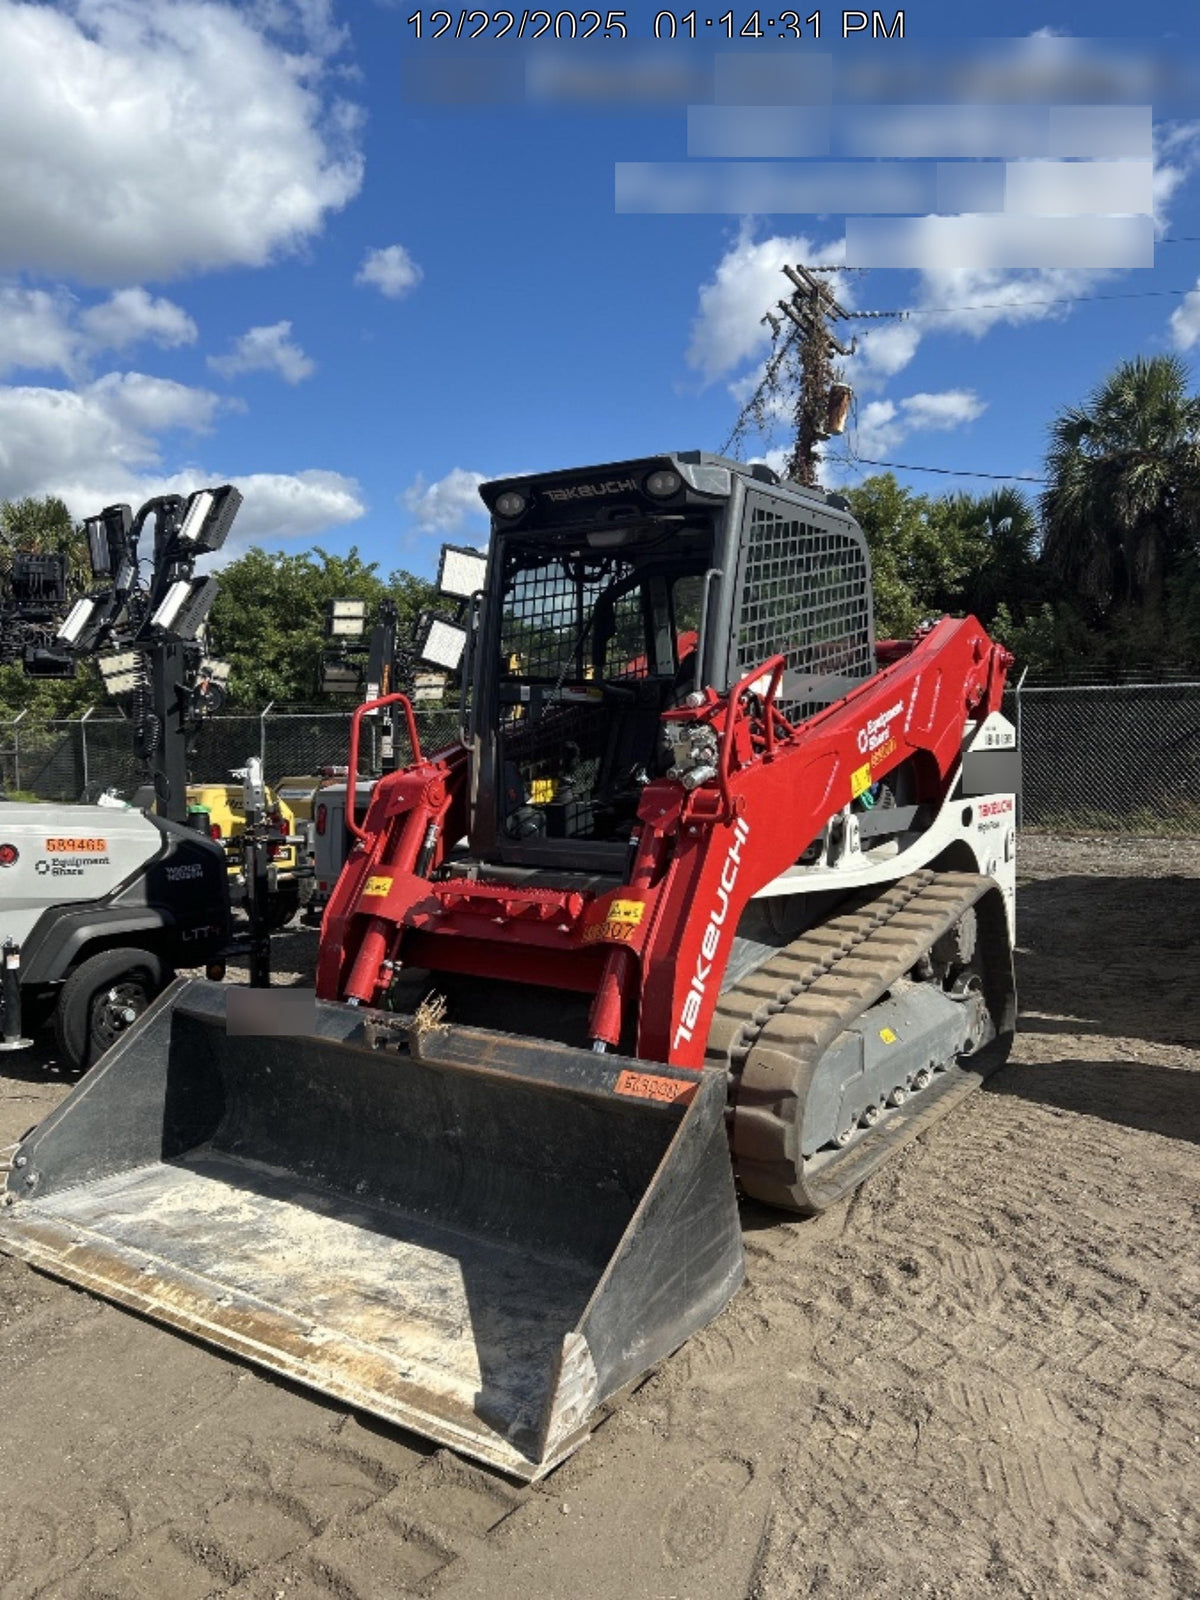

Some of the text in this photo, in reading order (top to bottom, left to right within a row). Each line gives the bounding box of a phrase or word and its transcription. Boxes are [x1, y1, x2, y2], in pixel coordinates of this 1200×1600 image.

[542, 479, 638, 502] TAKEUCHI
[47, 838, 105, 852] 589465
[52, 857, 110, 868] Equipment
[673, 817, 749, 1049] TAKEUCHI
